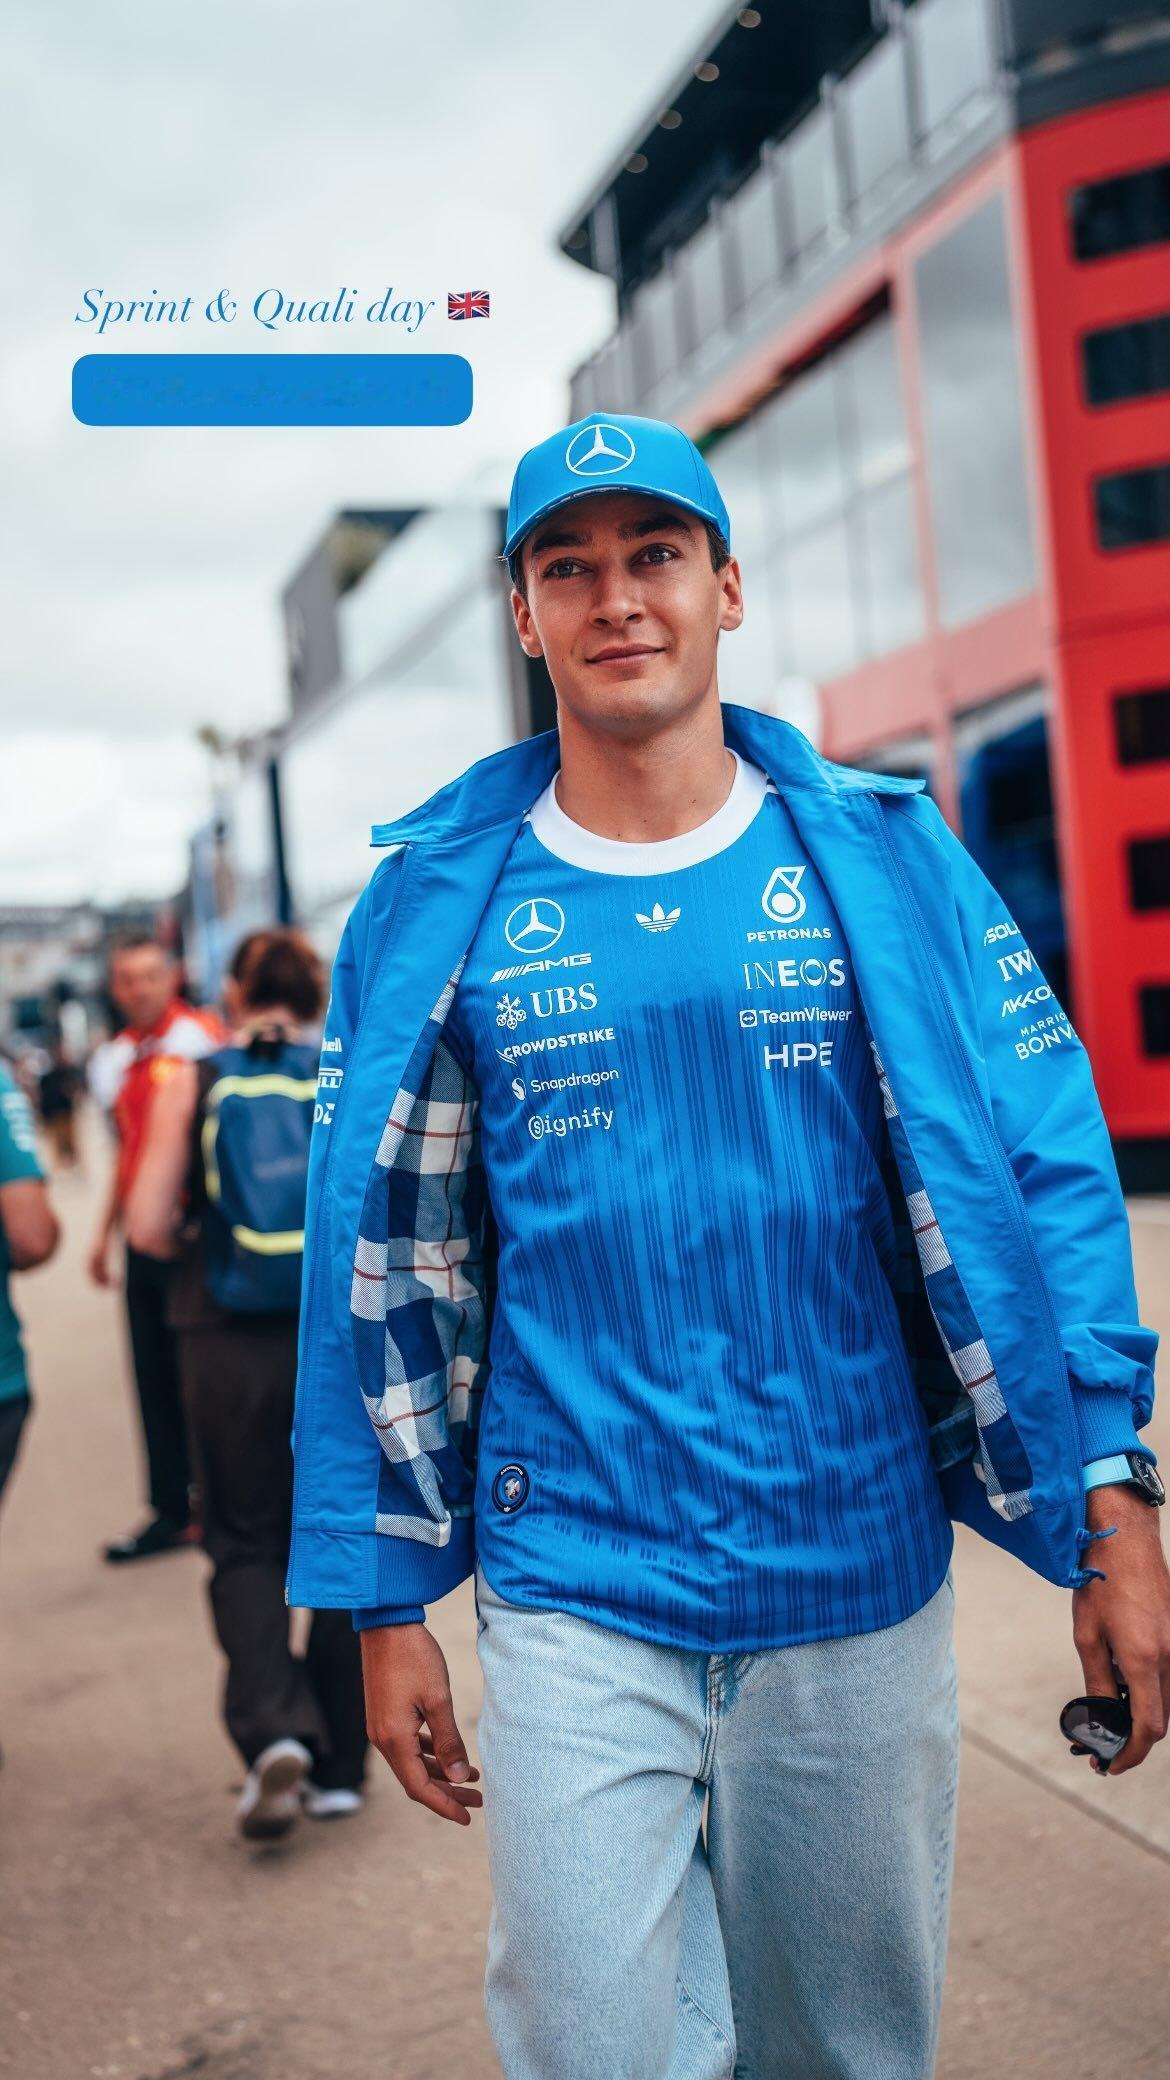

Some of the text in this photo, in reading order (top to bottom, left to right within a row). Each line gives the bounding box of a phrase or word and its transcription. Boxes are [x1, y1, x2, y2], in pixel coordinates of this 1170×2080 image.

[746, 927, 832, 943] PETRONAS
[986, 920, 1021, 944] SOL
[521, 952, 592, 976] AMG
[742, 958, 846, 990] INEOS
[996, 949, 1040, 981] IW
[530, 982, 598, 1018] UBS
[758, 1006, 853, 1024] TeamViewer
[1001, 985, 1055, 1017] AKKO
[502, 1027, 616, 1060] CROWDSTRIKE
[763, 1041, 834, 1070] HPE
[1014, 1024, 1078, 1060] BONV
[530, 1068, 619, 1093] Snapdragon
[528, 1106, 614, 1140] Signify
